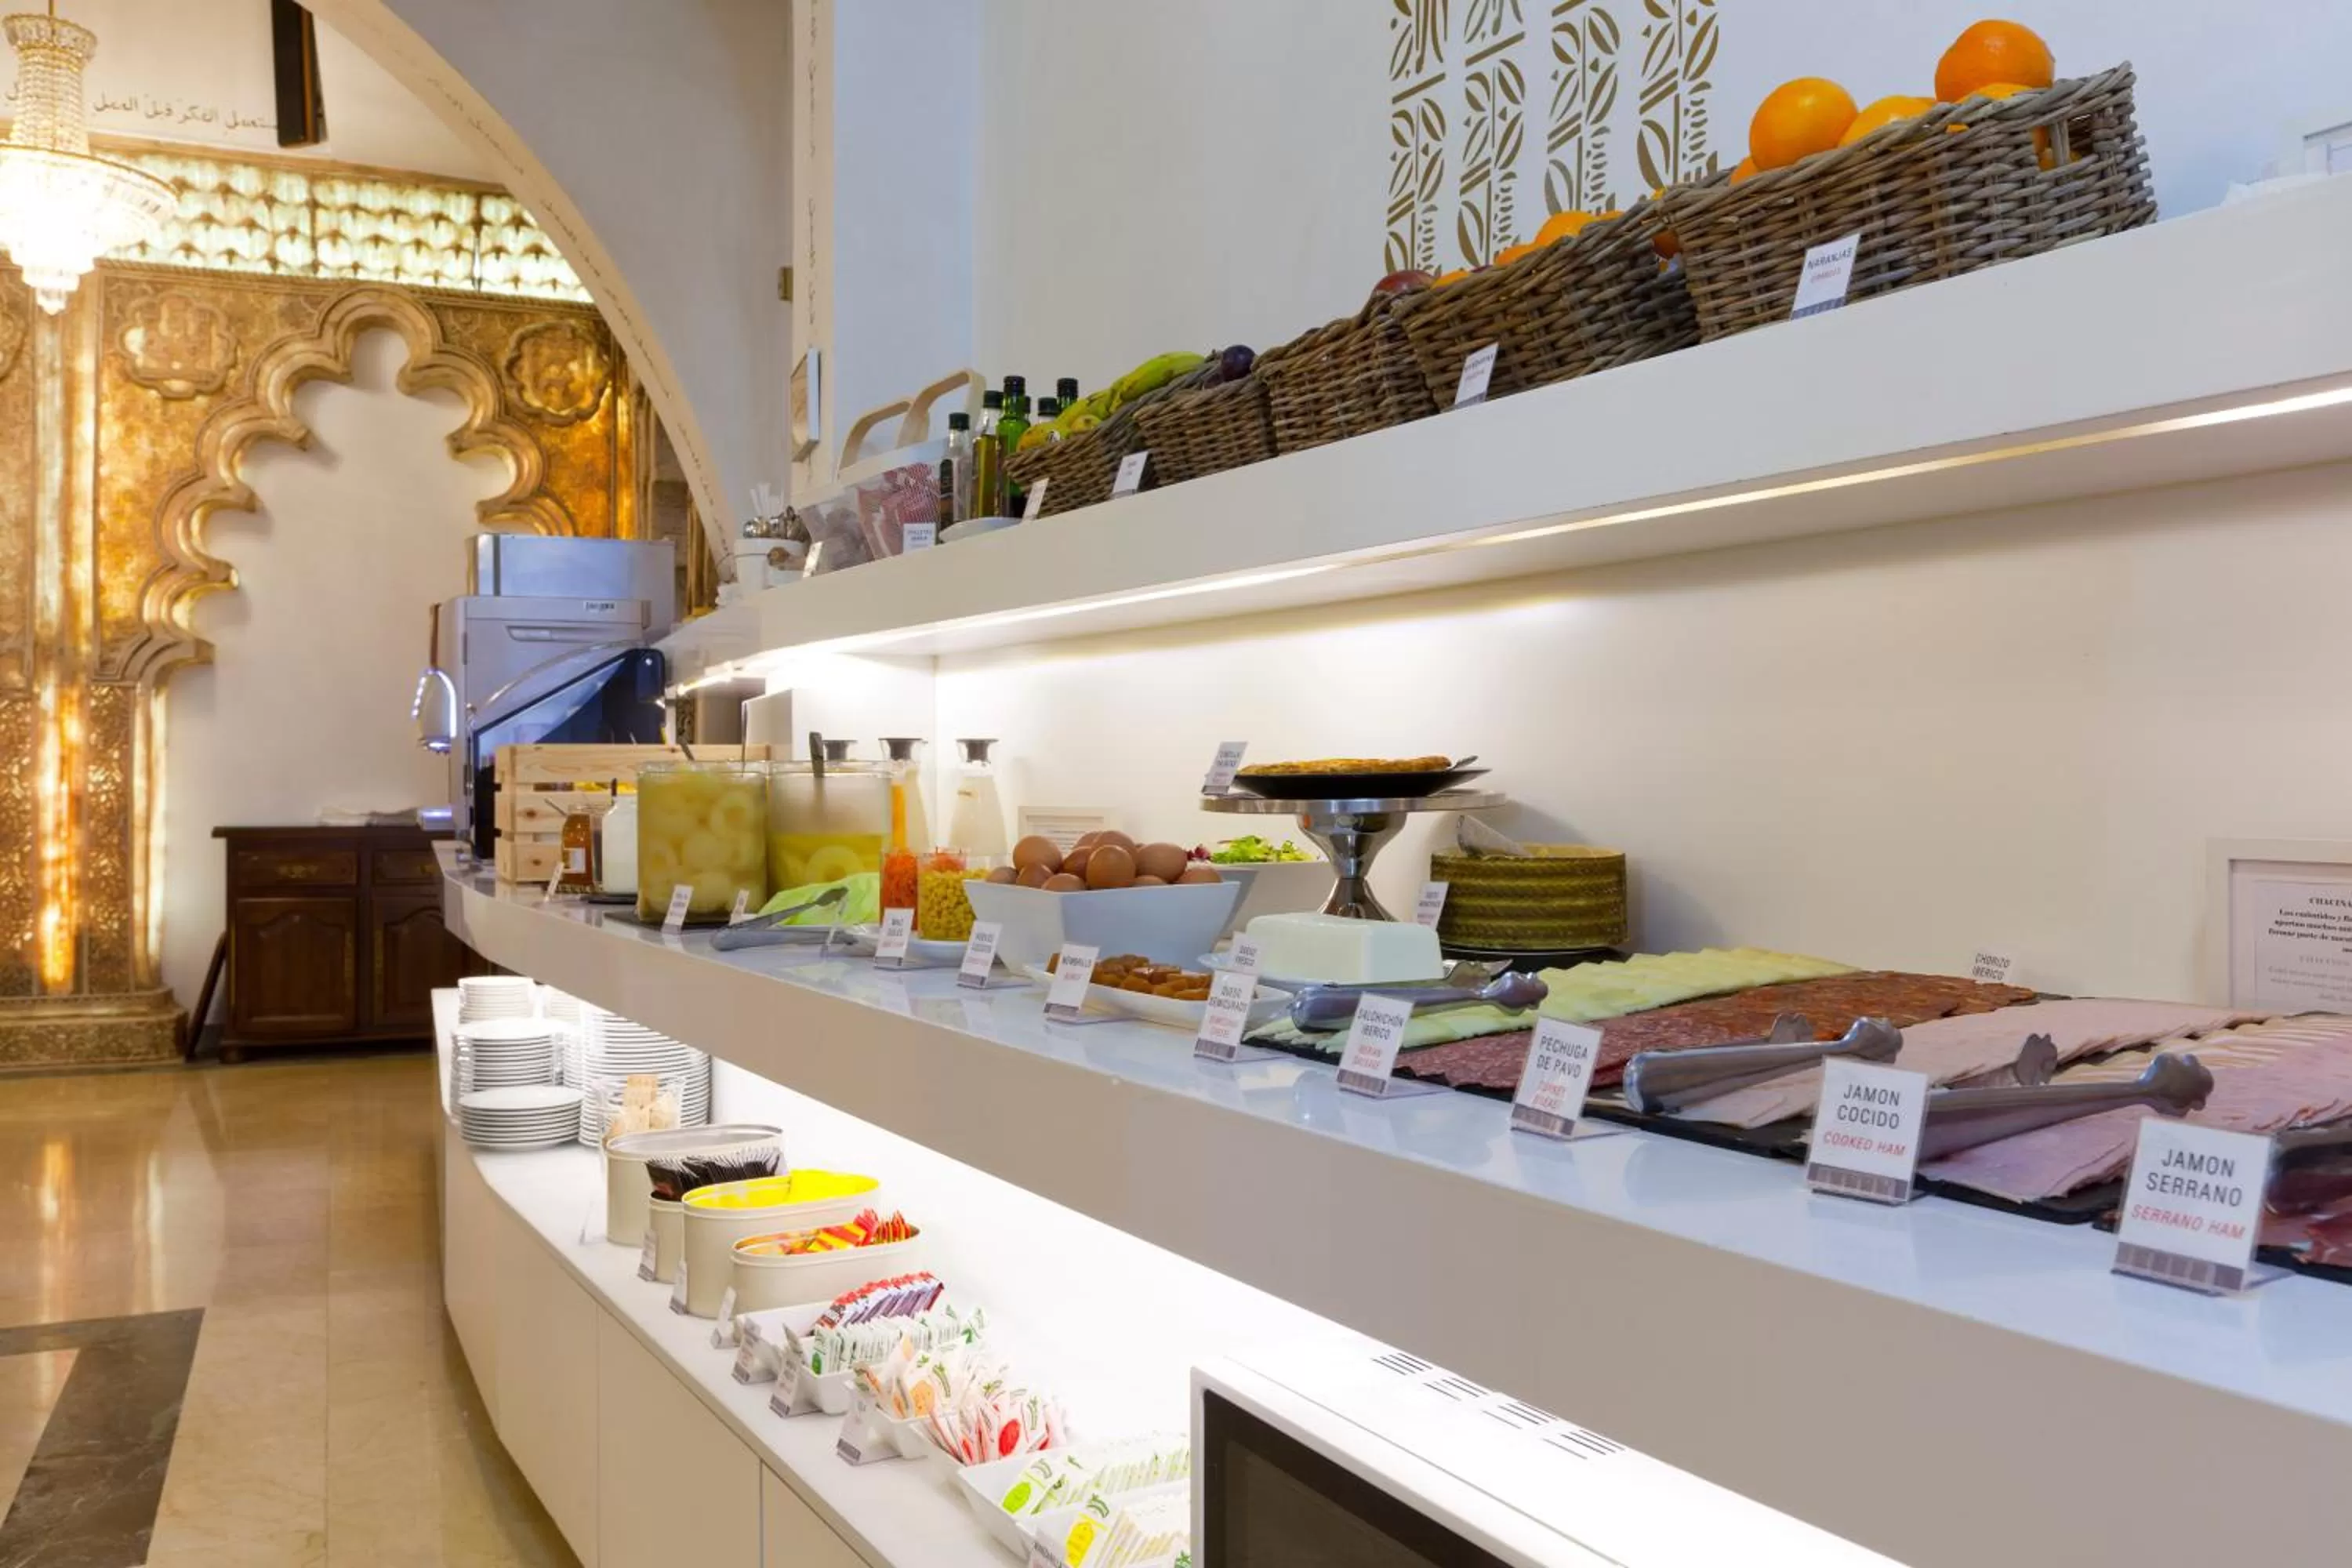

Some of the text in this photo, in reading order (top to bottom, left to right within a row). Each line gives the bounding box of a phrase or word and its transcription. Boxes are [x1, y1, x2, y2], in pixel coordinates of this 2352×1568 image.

[1975, 953, 2011, 968] CHORIZO
[1361, 1025, 1392, 1040] IBERICO
[1539, 1035, 1588, 1059] PECHUGA
[1536, 1054, 1582, 1079] DE PAVO
[1843, 1083, 1900, 1107] JAMON
[1837, 1104, 1900, 1130] COCIDO
[1823, 1131, 1907, 1156] COOKED HAM
[2161, 1148, 2235, 1178] JAMON
[2145, 1172, 2243, 1207] SERRANO
[2130, 1203, 2246, 1240] SERRANO HAM
